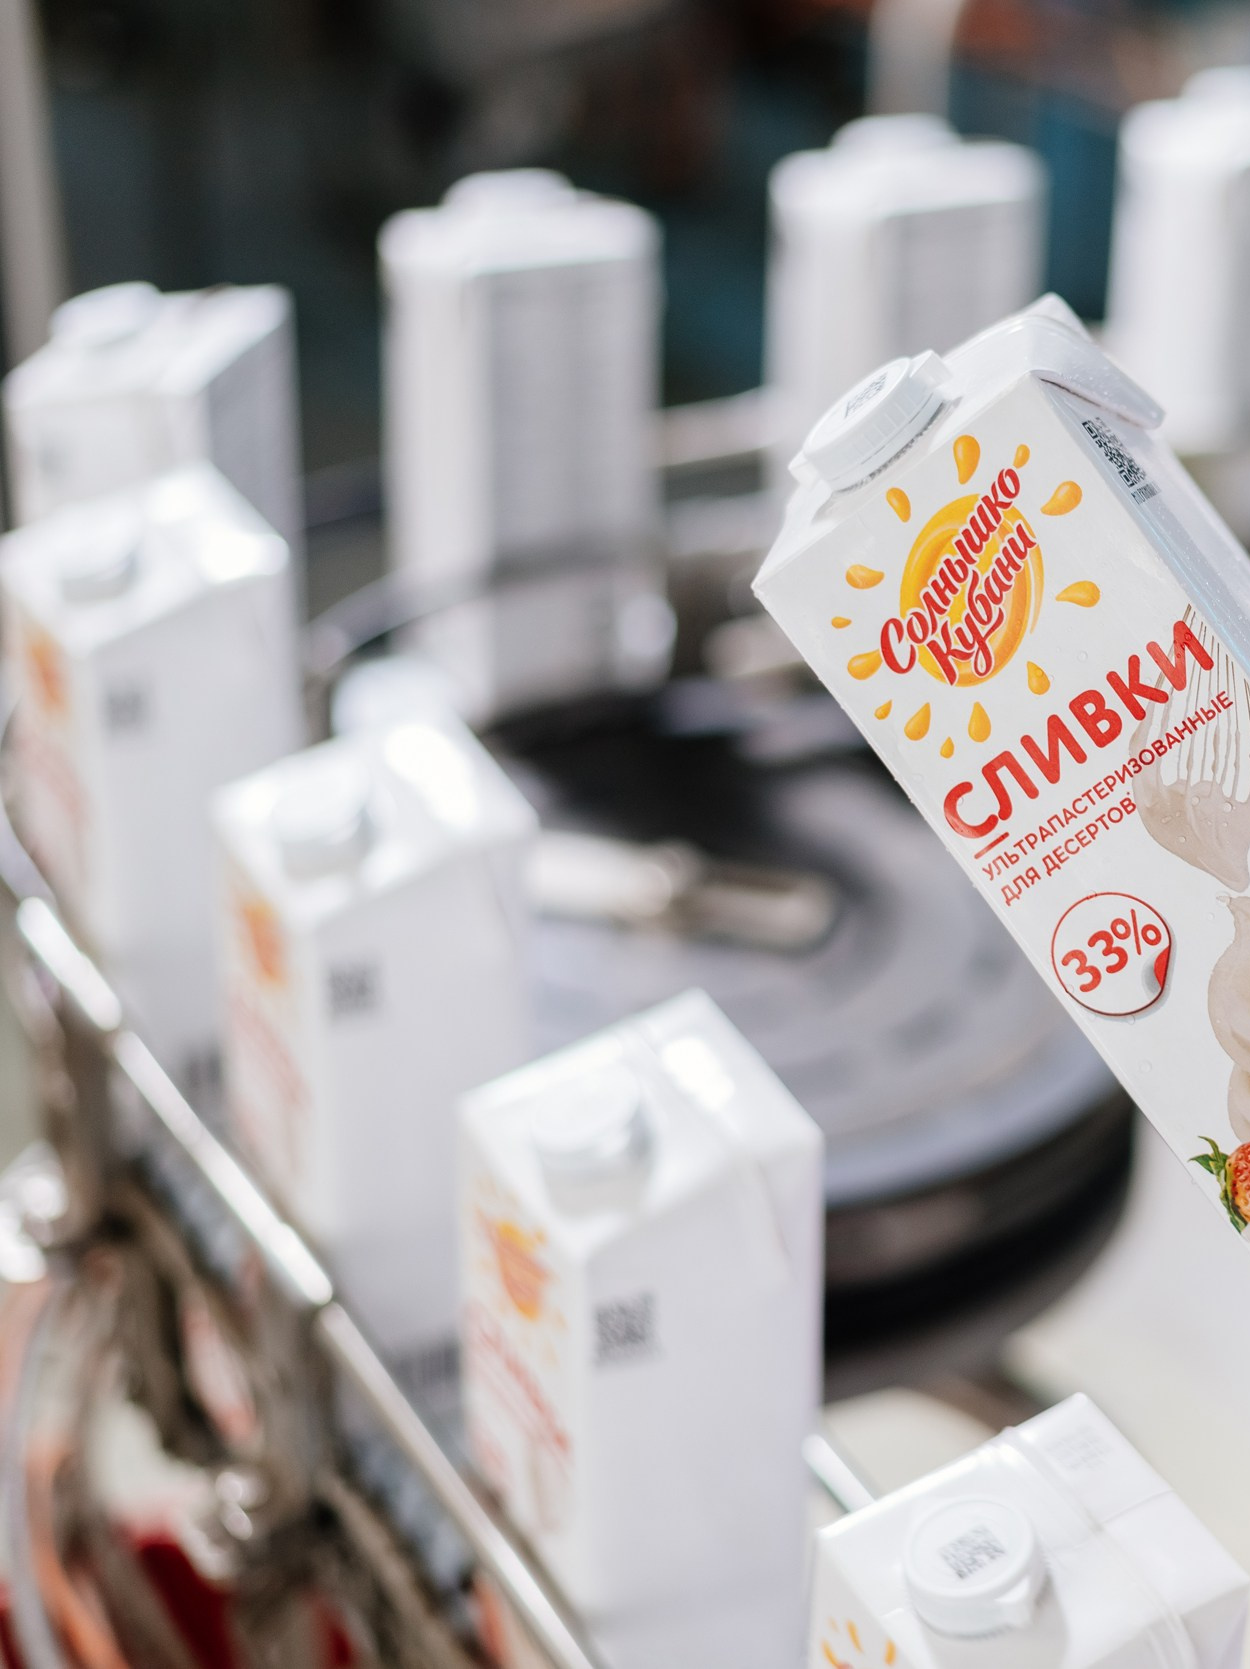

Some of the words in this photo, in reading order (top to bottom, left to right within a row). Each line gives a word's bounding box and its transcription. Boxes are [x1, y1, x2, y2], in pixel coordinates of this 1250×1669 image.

[880, 468, 1020, 674] Солнышко
[926, 523, 1037, 686] Кубани
[943, 620, 1214, 839] СЛИВКИ
[982, 690, 1234, 881] УЛЬТРАПАСТЕРИЗОВАННЫЕ
[1000, 867, 1042, 906] ДЛЯ
[1042, 797, 1137, 876] ДЕСЕРТОВ
[1061, 908, 1162, 992] 33%
